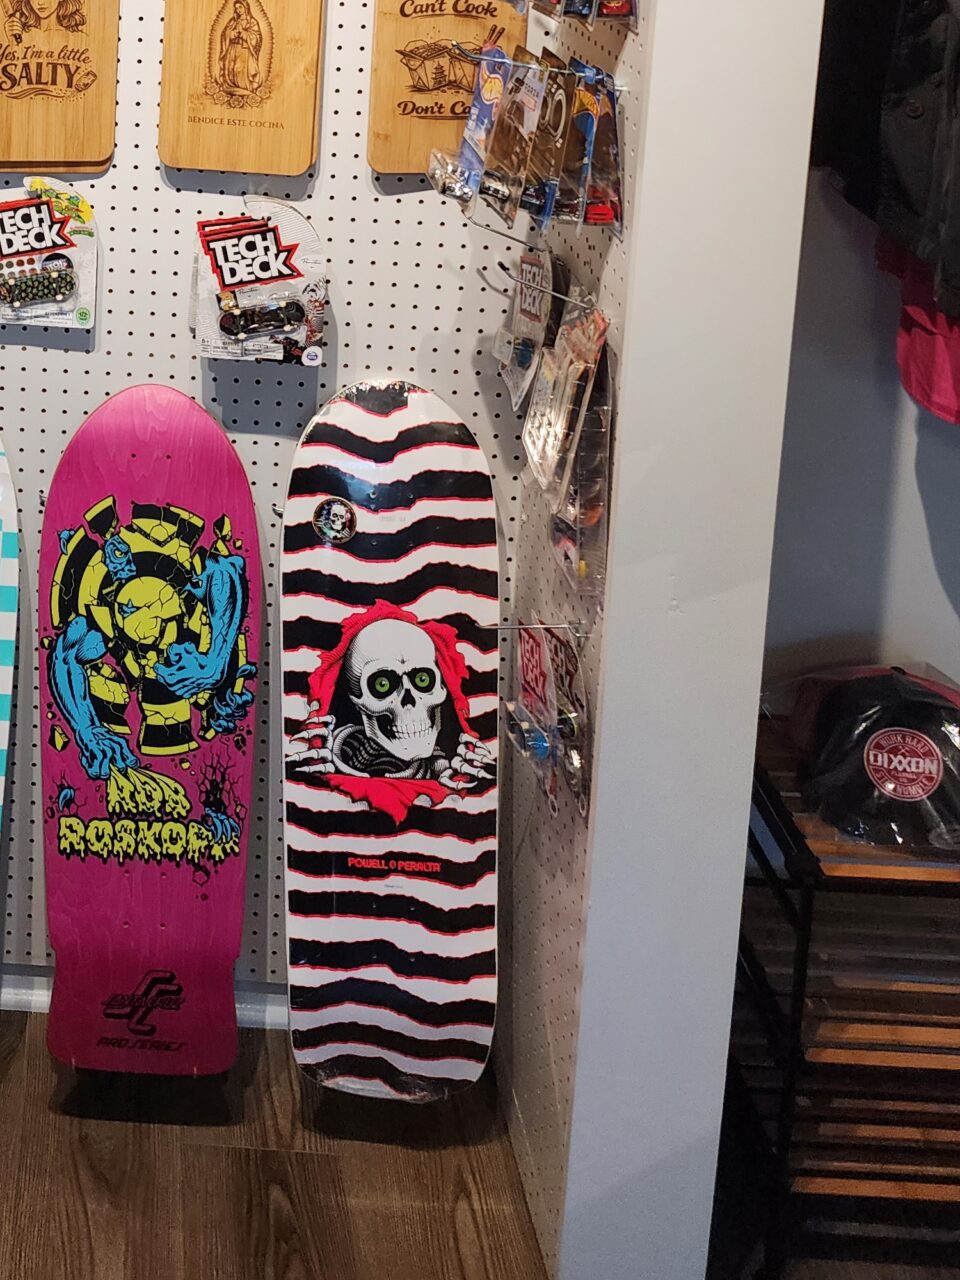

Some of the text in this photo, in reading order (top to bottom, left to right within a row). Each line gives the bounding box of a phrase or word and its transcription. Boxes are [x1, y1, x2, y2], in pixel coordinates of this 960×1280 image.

[22, 45, 44, 60] I'm
[46, 51, 55, 59] a
[58, 45, 92, 64] little
[0, 62, 81, 92] SALTY
[397, 101, 445, 116] Don't
[188, 116, 285, 130] BENDICE ESTE COCINA
[0, 223, 66, 255] DECK
[209, 232, 278, 266] TECH
[221, 252, 293, 285] DECK
[869, 751, 938, 774] DIXXON
[348, 857, 441, 873] POWELL PERALTA
[96, 1036, 188, 1052] PRO SERIES
